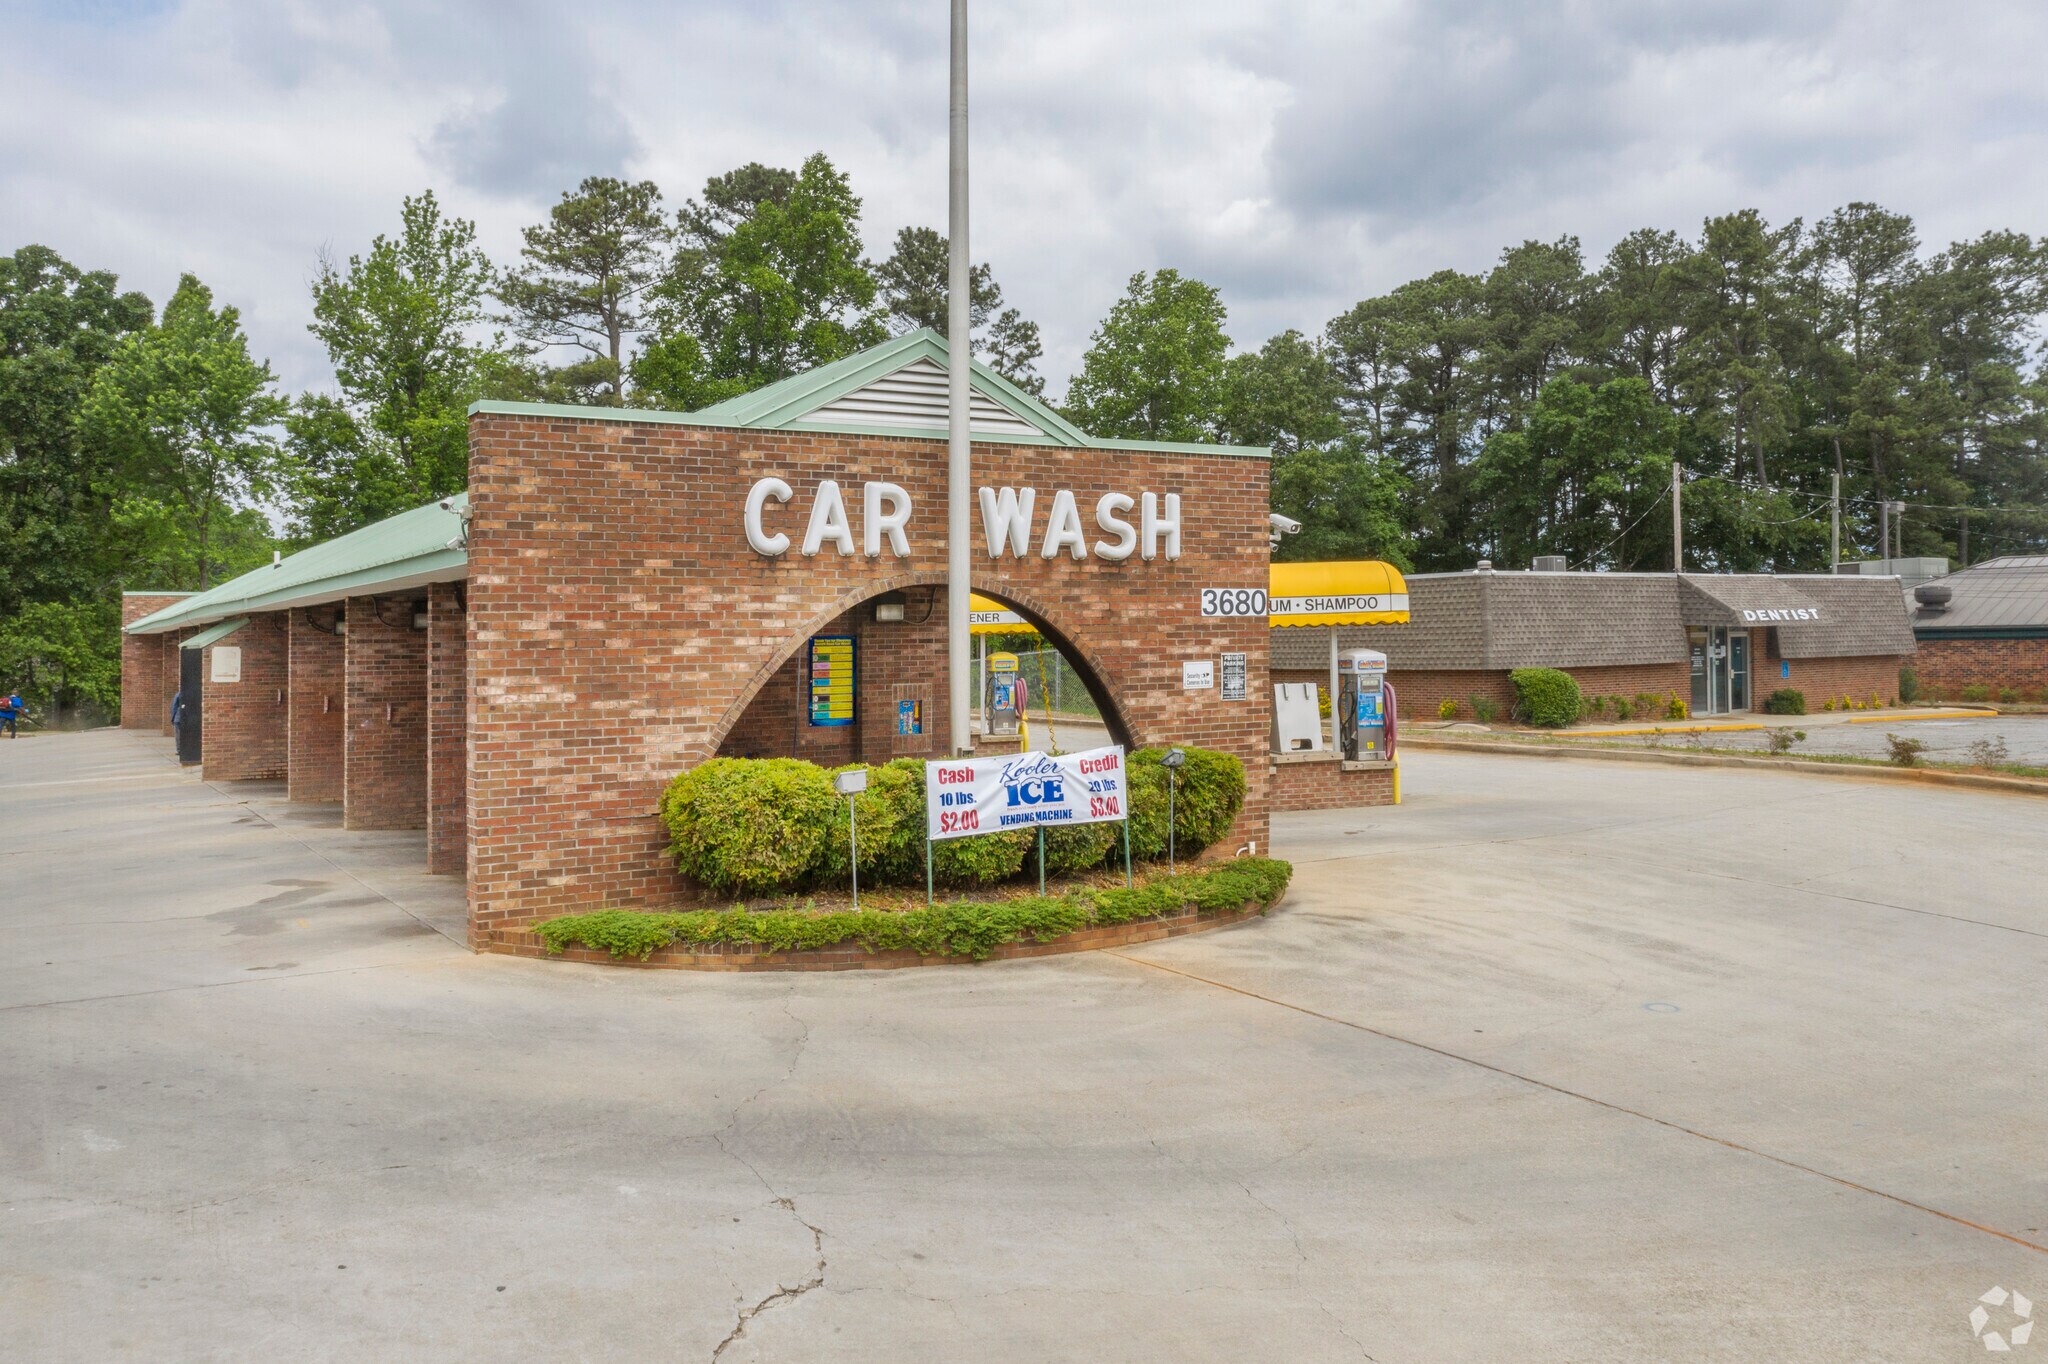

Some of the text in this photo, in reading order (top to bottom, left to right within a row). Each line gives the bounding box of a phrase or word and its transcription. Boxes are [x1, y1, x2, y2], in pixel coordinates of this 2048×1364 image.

[744, 477, 1181, 562] CAR WASH
[1202, 589, 1266, 615] 3680
[1305, 596, 1378, 611] SHAMPOO
[1743, 608, 1819, 621] DENTIST
[1000, 757, 1065, 783] Kooler
[1080, 754, 1118, 774] Credit
[938, 767, 974, 785] Cash
[1088, 779, 1117, 792] 20 lbs.
[940, 792, 977, 806] 10 lbs.
[1004, 775, 1064, 807] ICE
[1000, 809, 1073, 825] VENDING MACHINE
[1090, 796, 1119, 818] $3.00
[941, 809, 979, 834] $2.00
